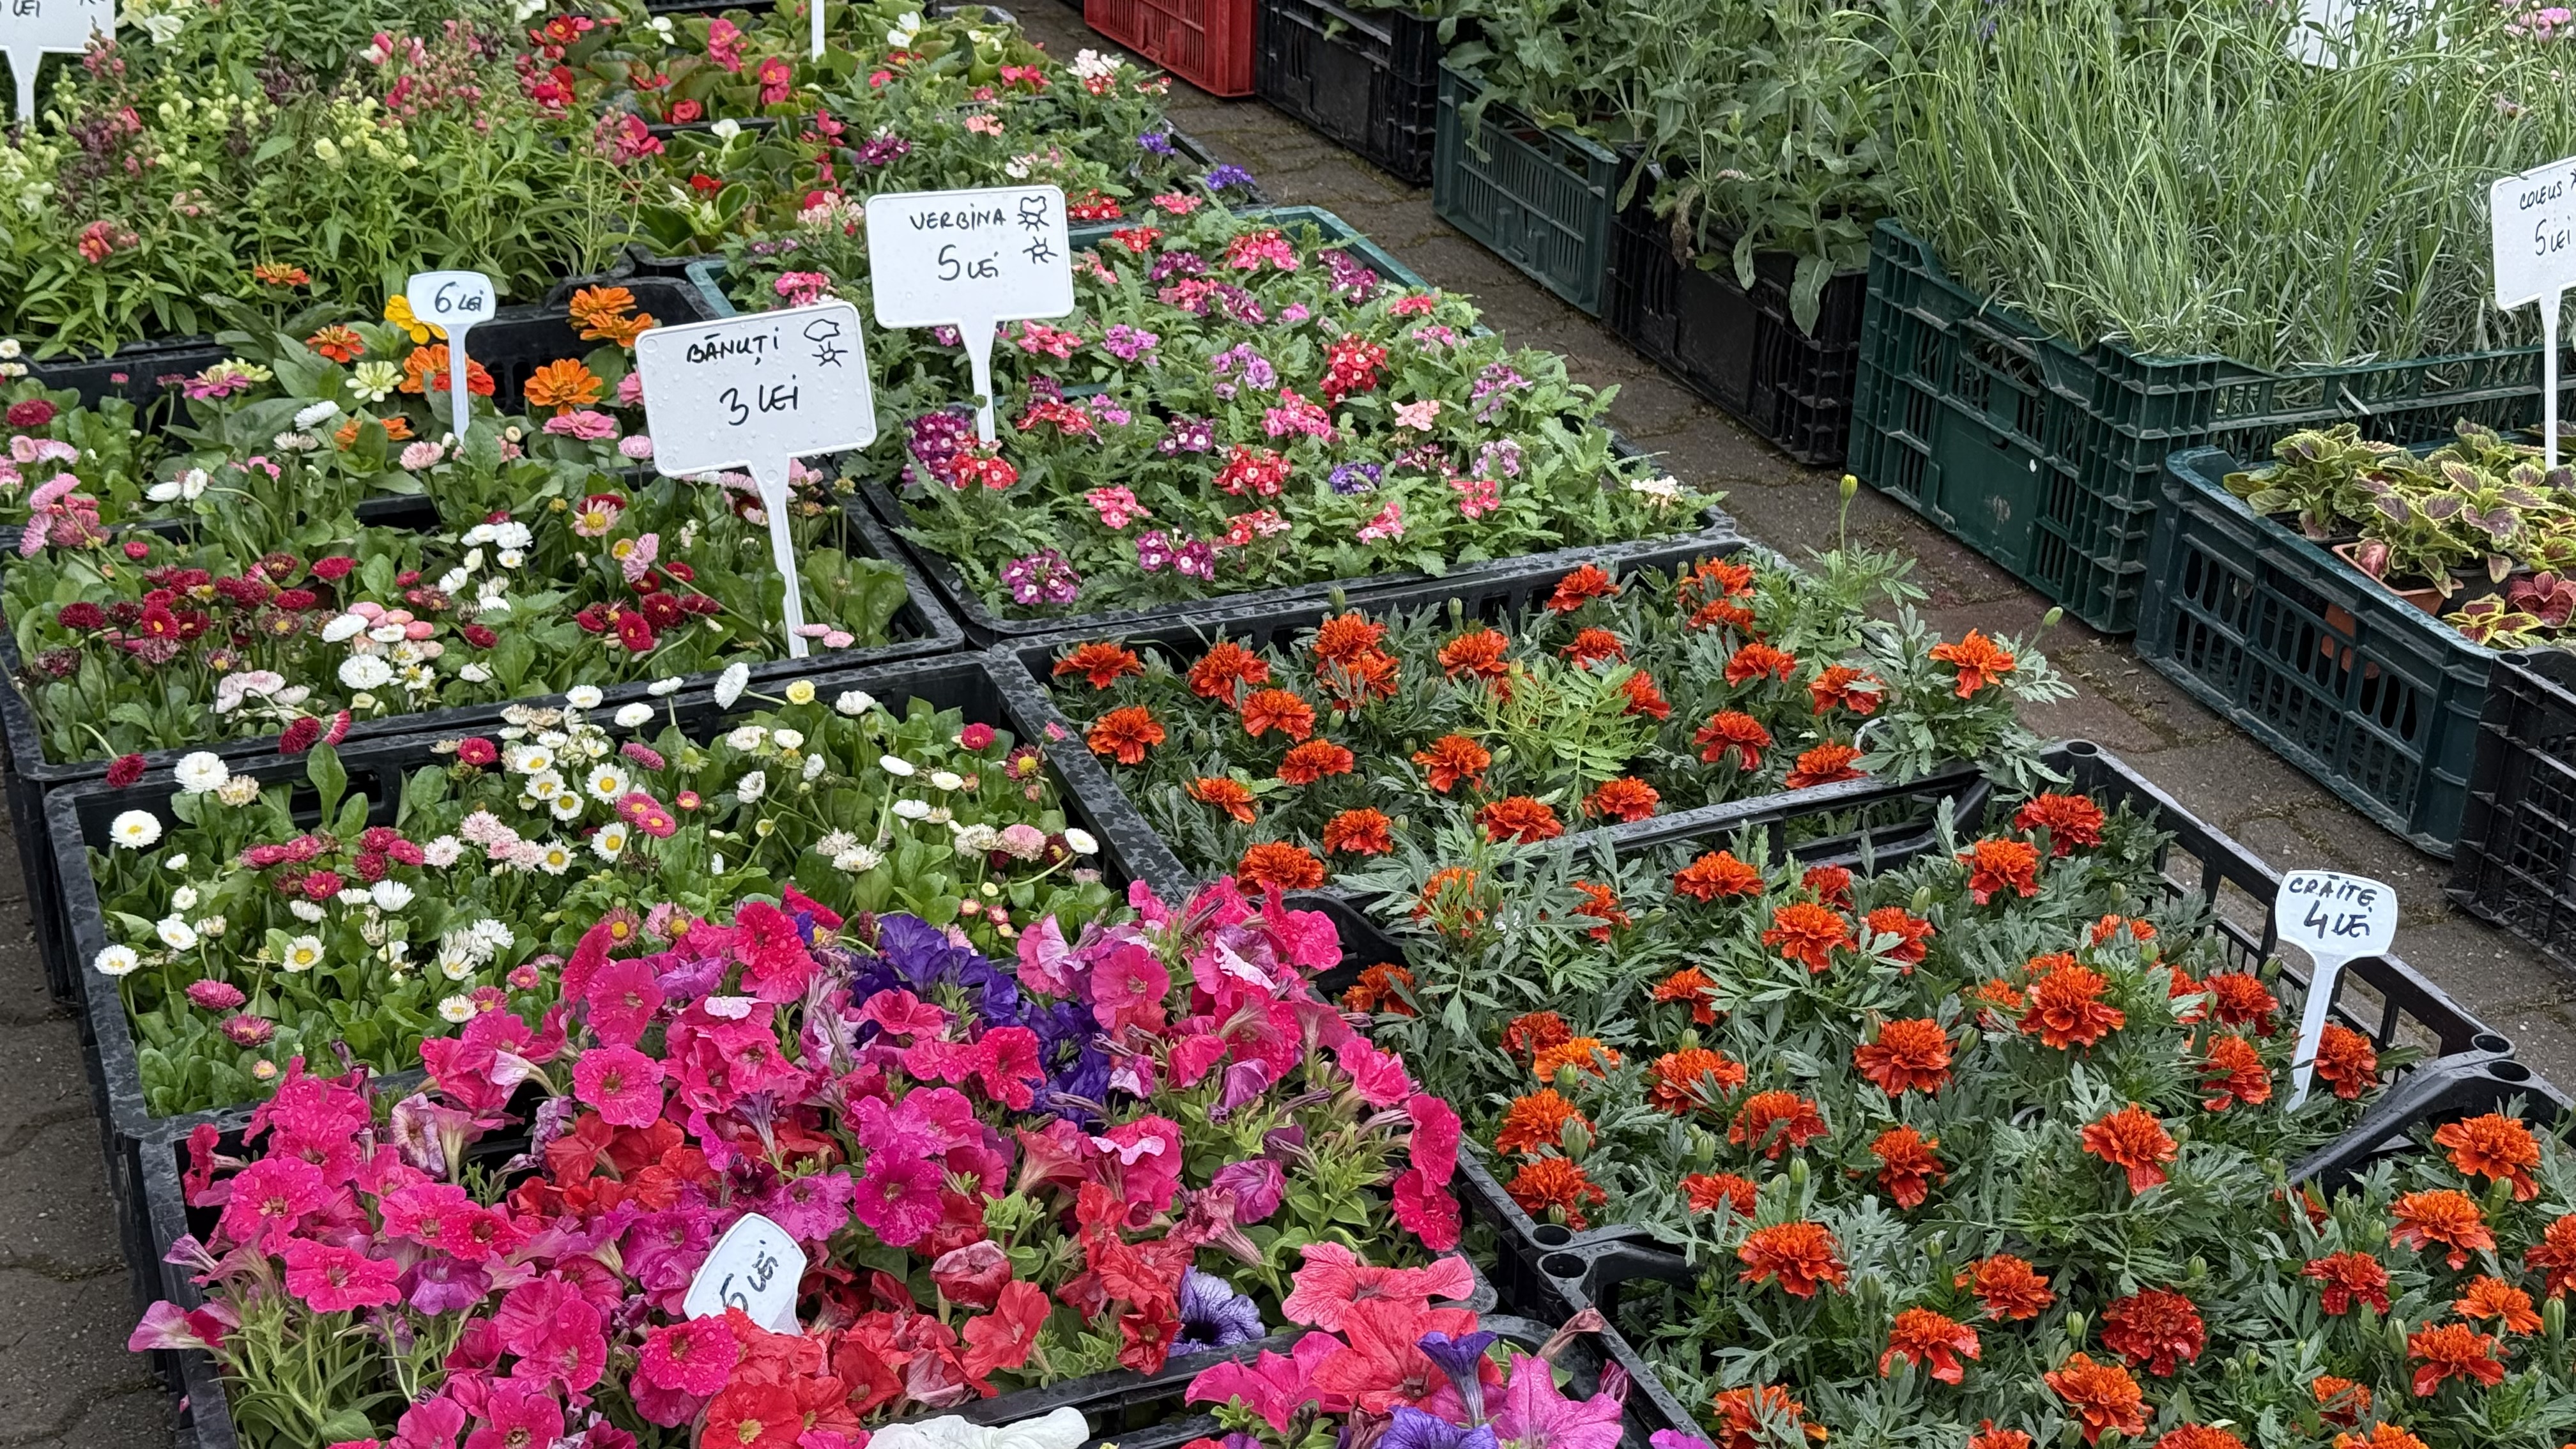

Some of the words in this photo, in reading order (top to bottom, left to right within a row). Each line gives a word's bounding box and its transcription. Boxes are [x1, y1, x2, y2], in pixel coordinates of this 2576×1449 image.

[2520, 180, 2562, 210] COLEUS
[909, 203, 1007, 231] VERBINA
[2535, 218, 2547, 256] 5
[938, 244, 961, 281] 5
[435, 281, 456, 313] 6
[719, 388, 749, 426] 3
[2303, 900, 2329, 939] 4
